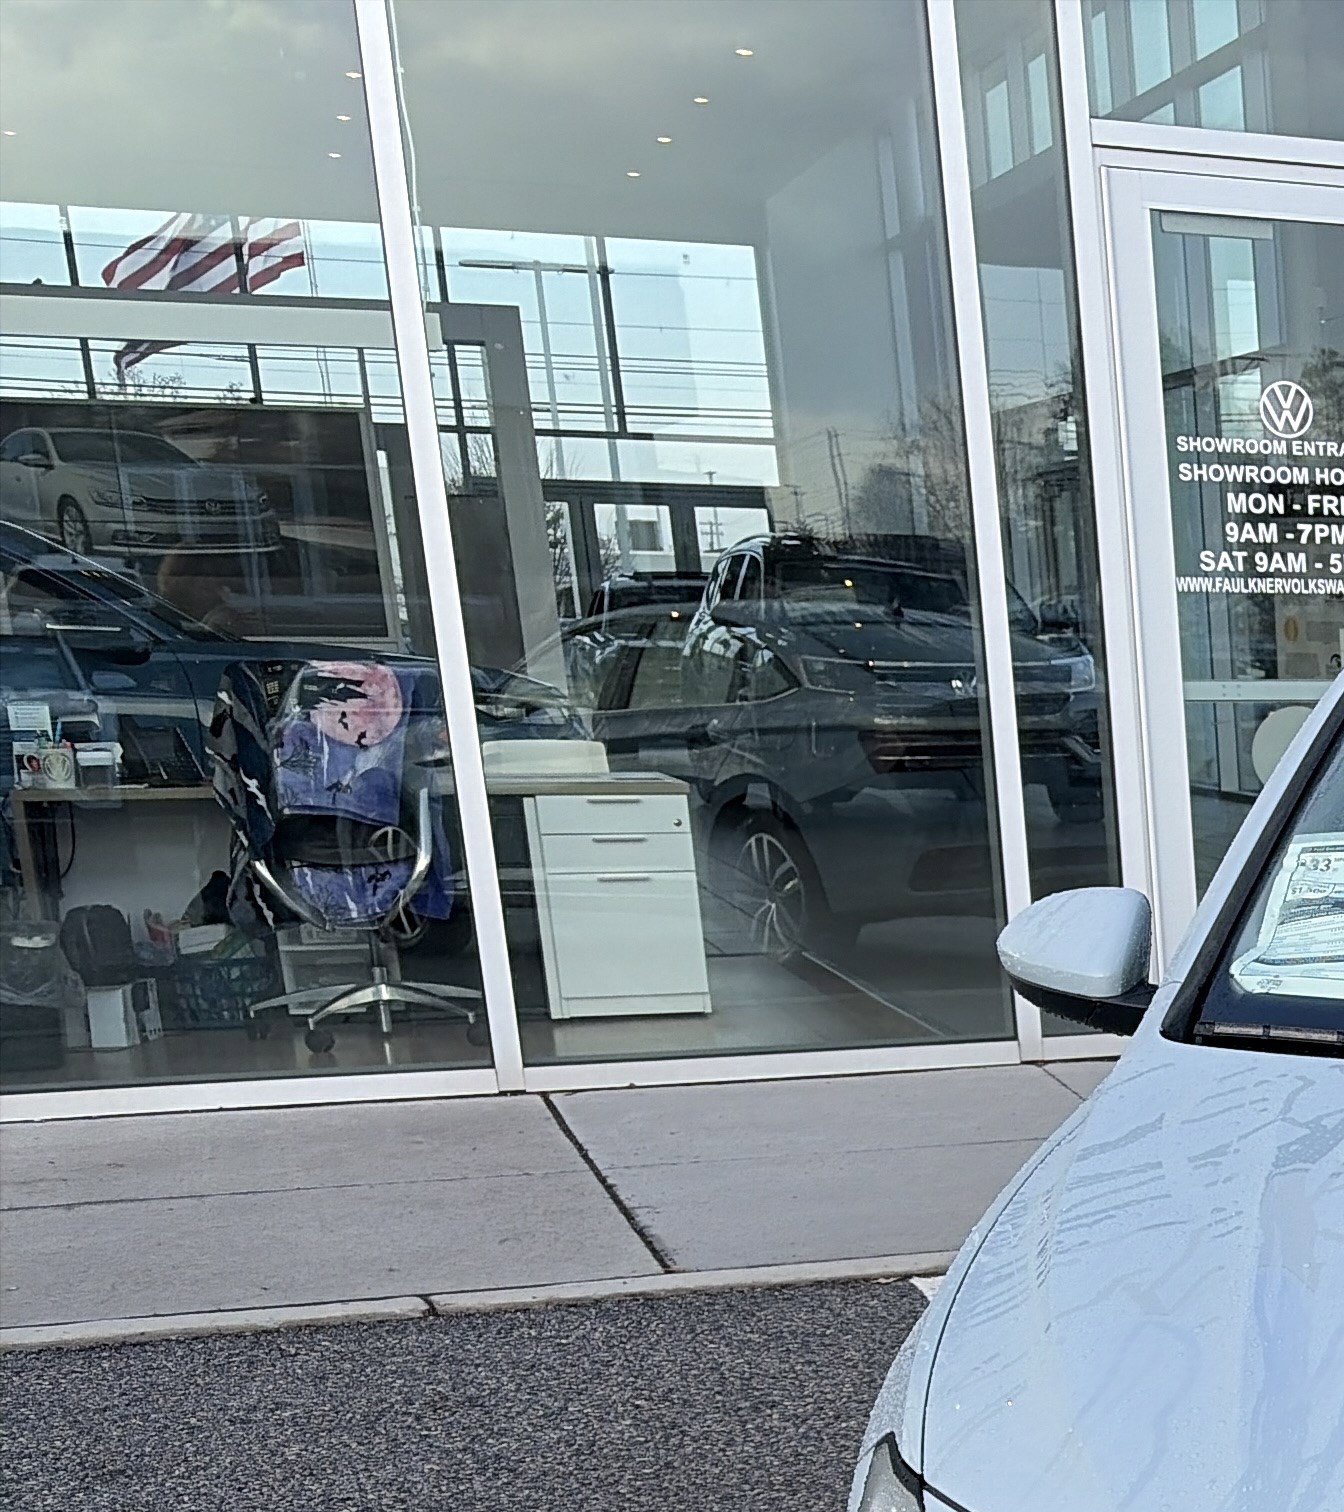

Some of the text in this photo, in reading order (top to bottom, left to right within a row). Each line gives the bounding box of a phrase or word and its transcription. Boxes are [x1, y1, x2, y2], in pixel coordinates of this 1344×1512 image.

[1176, 436, 1287, 456] SHOWROOM
[1178, 463, 1309, 485] SHOWROOM
[1226, 492, 1284, 515] MON
[1225, 522, 1278, 543] 9AM
[1200, 551, 1248, 572] SAT
[1254, 552, 1307, 573] 9AM
